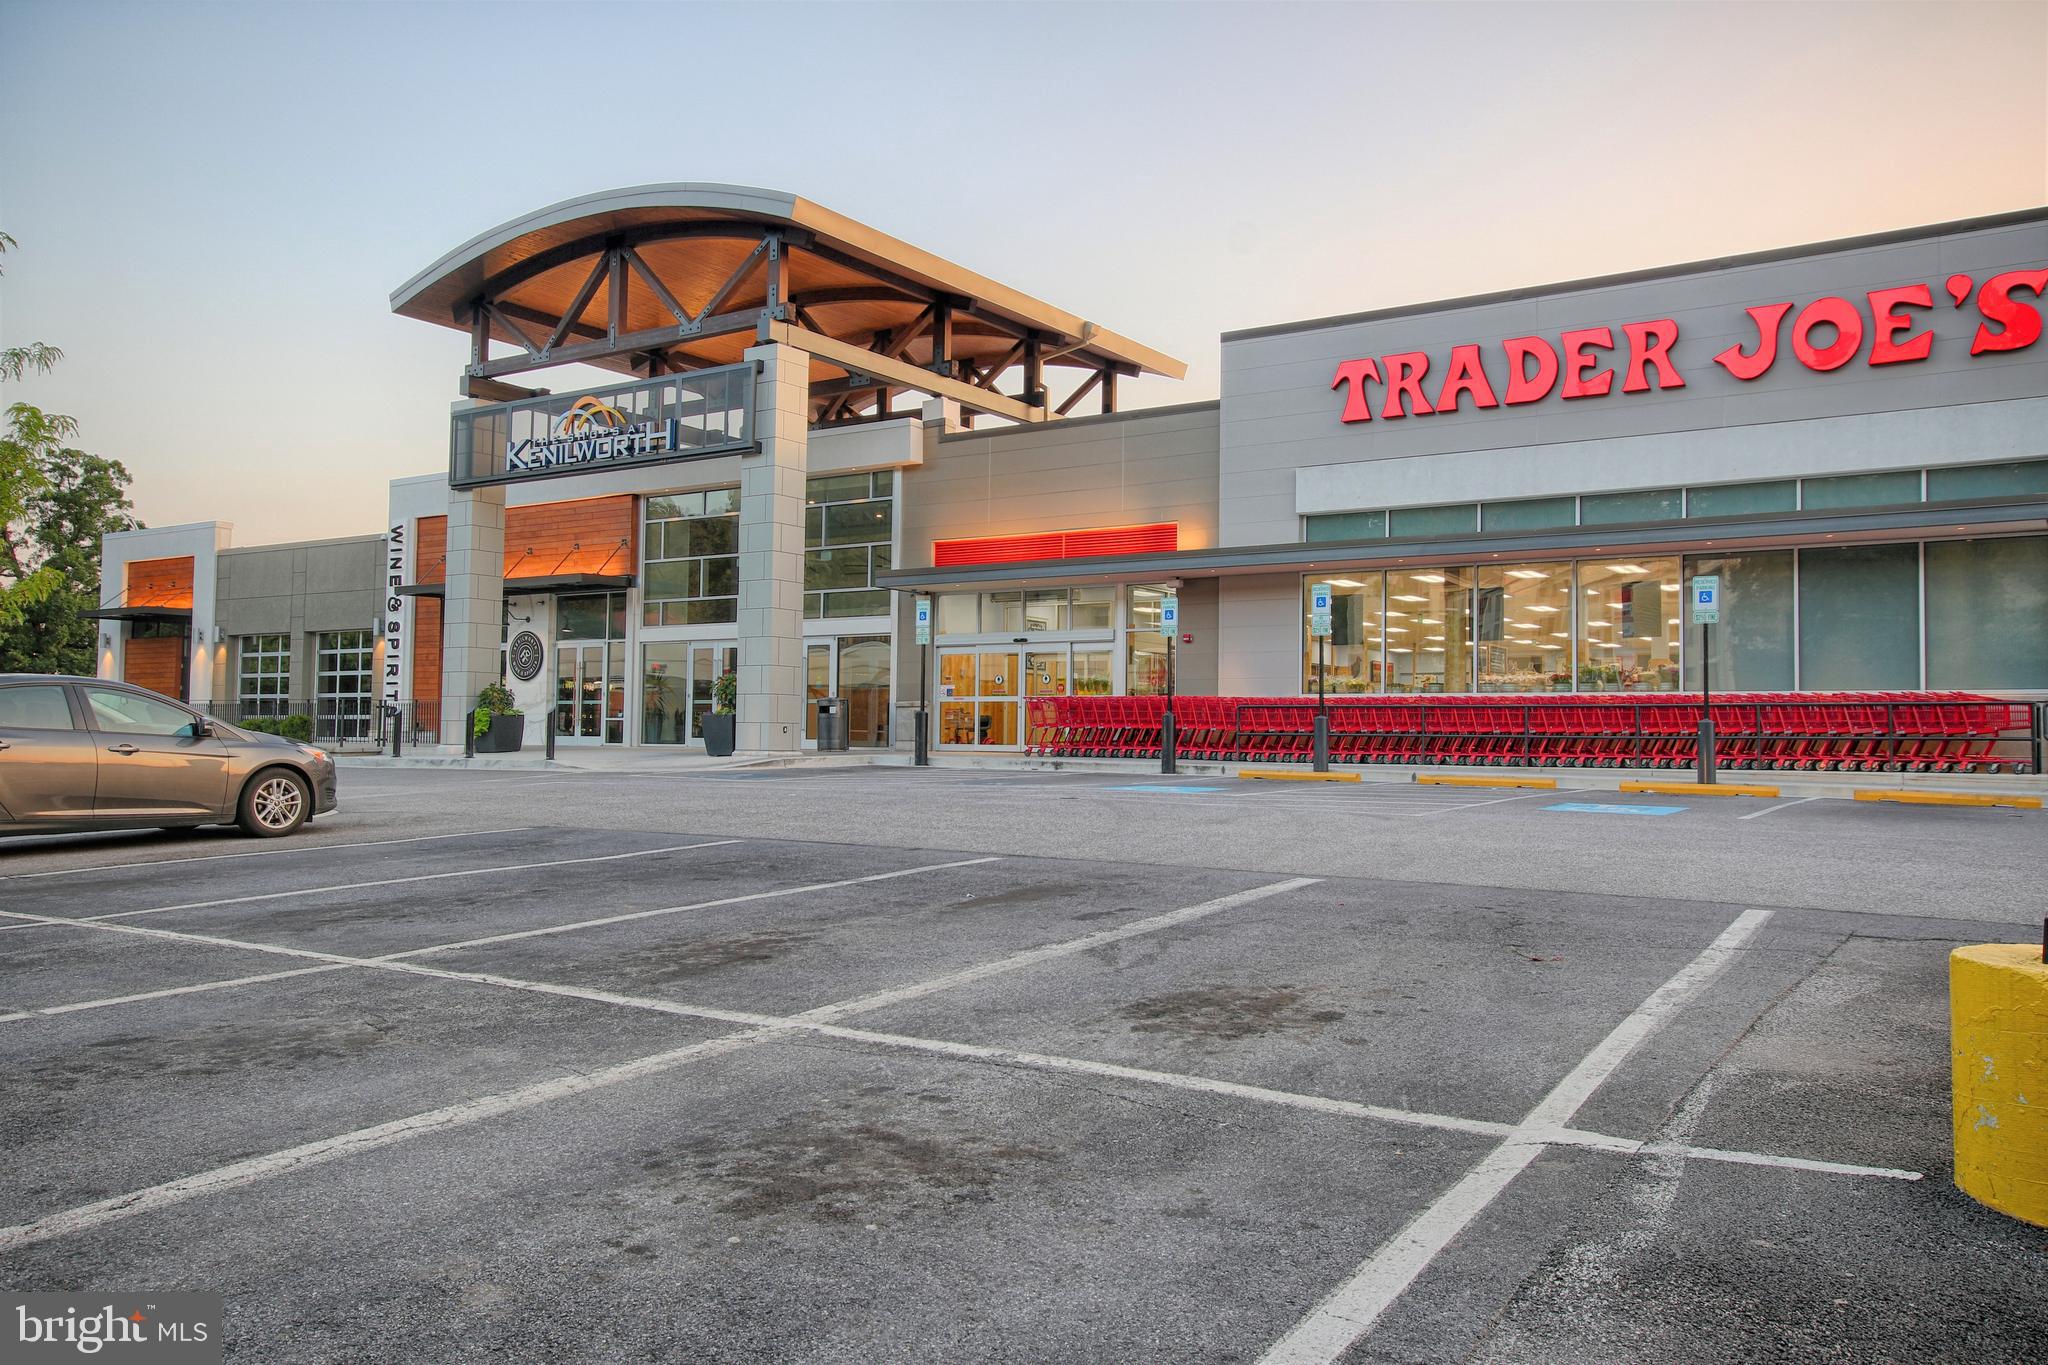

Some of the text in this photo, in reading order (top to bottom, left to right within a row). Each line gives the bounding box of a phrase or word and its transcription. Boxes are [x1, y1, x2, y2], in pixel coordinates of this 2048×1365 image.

[1331, 268, 2048, 424] TRADER JOE'S
[506, 417, 678, 471] KENILWORTH
[531, 422, 647, 448] THE SHOPS AT
[388, 524, 404, 587] WINE
[387, 594, 402, 613] &
